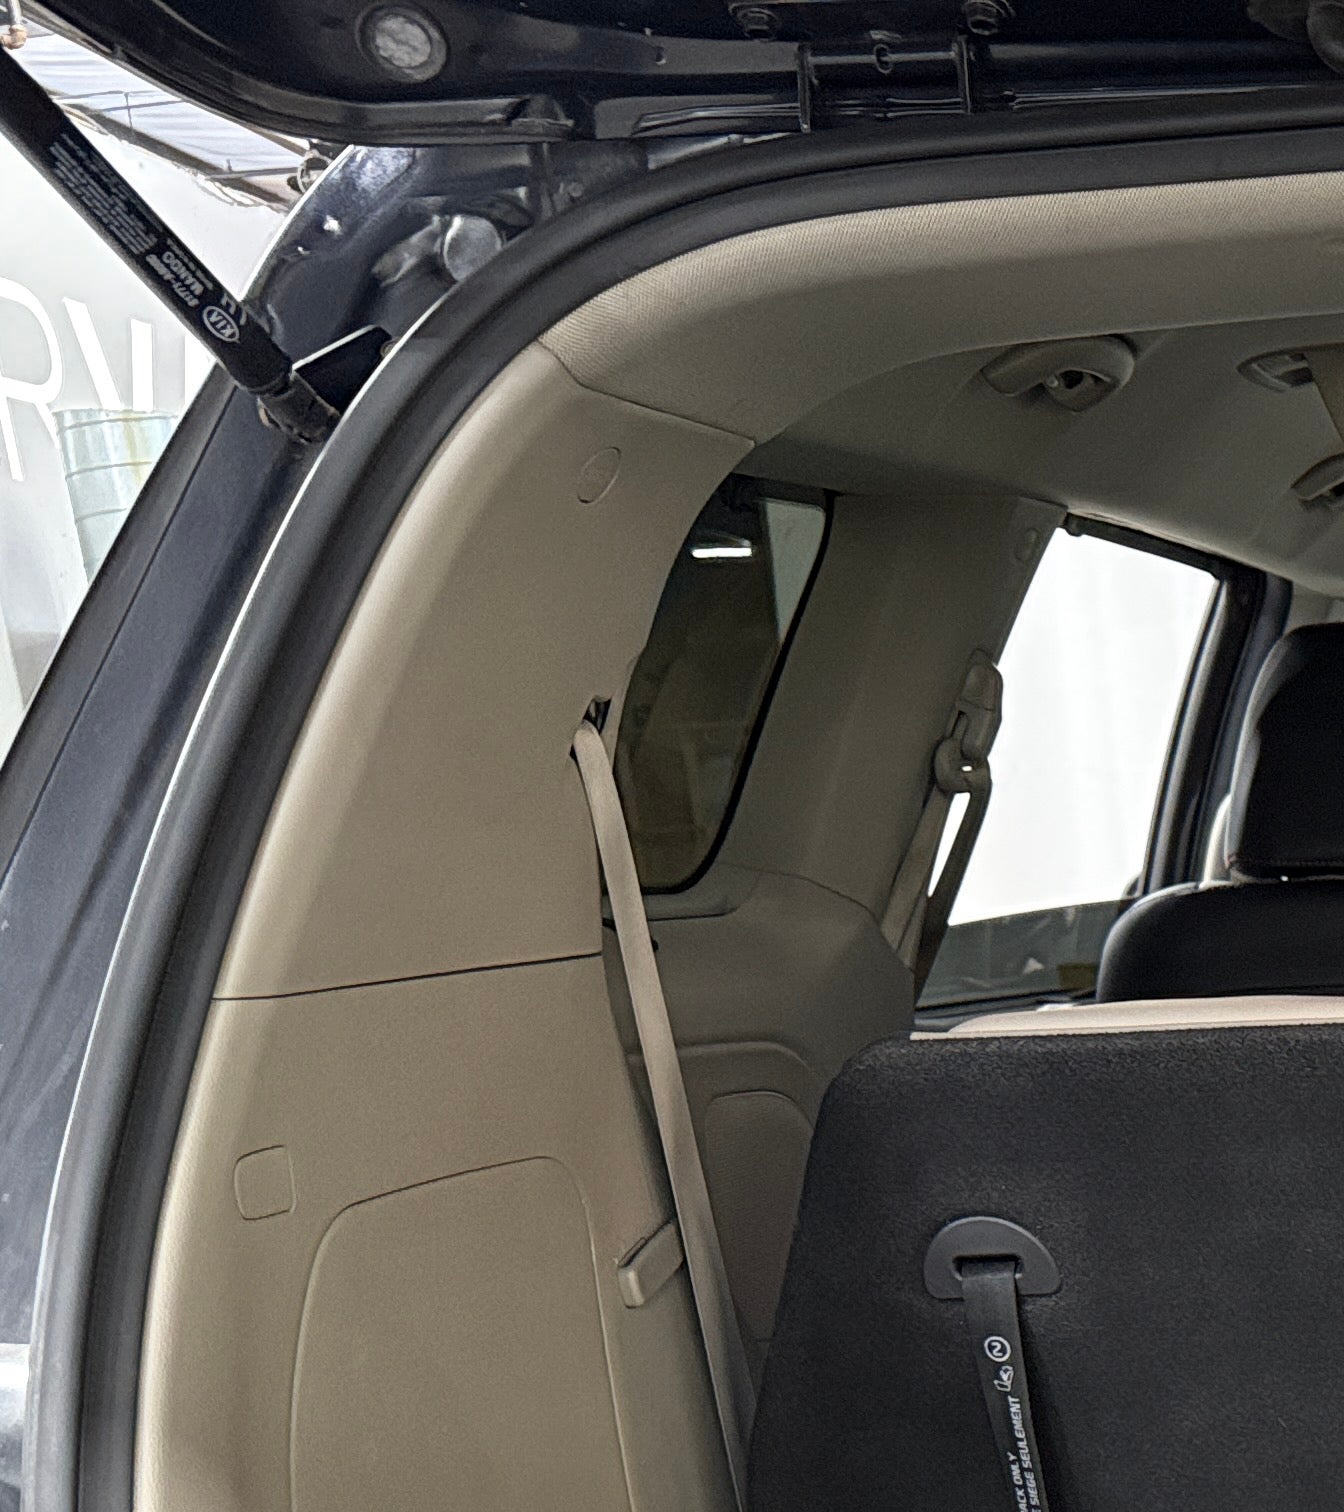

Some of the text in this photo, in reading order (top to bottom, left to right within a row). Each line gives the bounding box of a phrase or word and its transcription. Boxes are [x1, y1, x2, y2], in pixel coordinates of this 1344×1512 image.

[206, 308, 238, 340] KIA
[1007, 1395, 1033, 1470] SEULEMENT
[1007, 1452, 1023, 1485] ONLY
